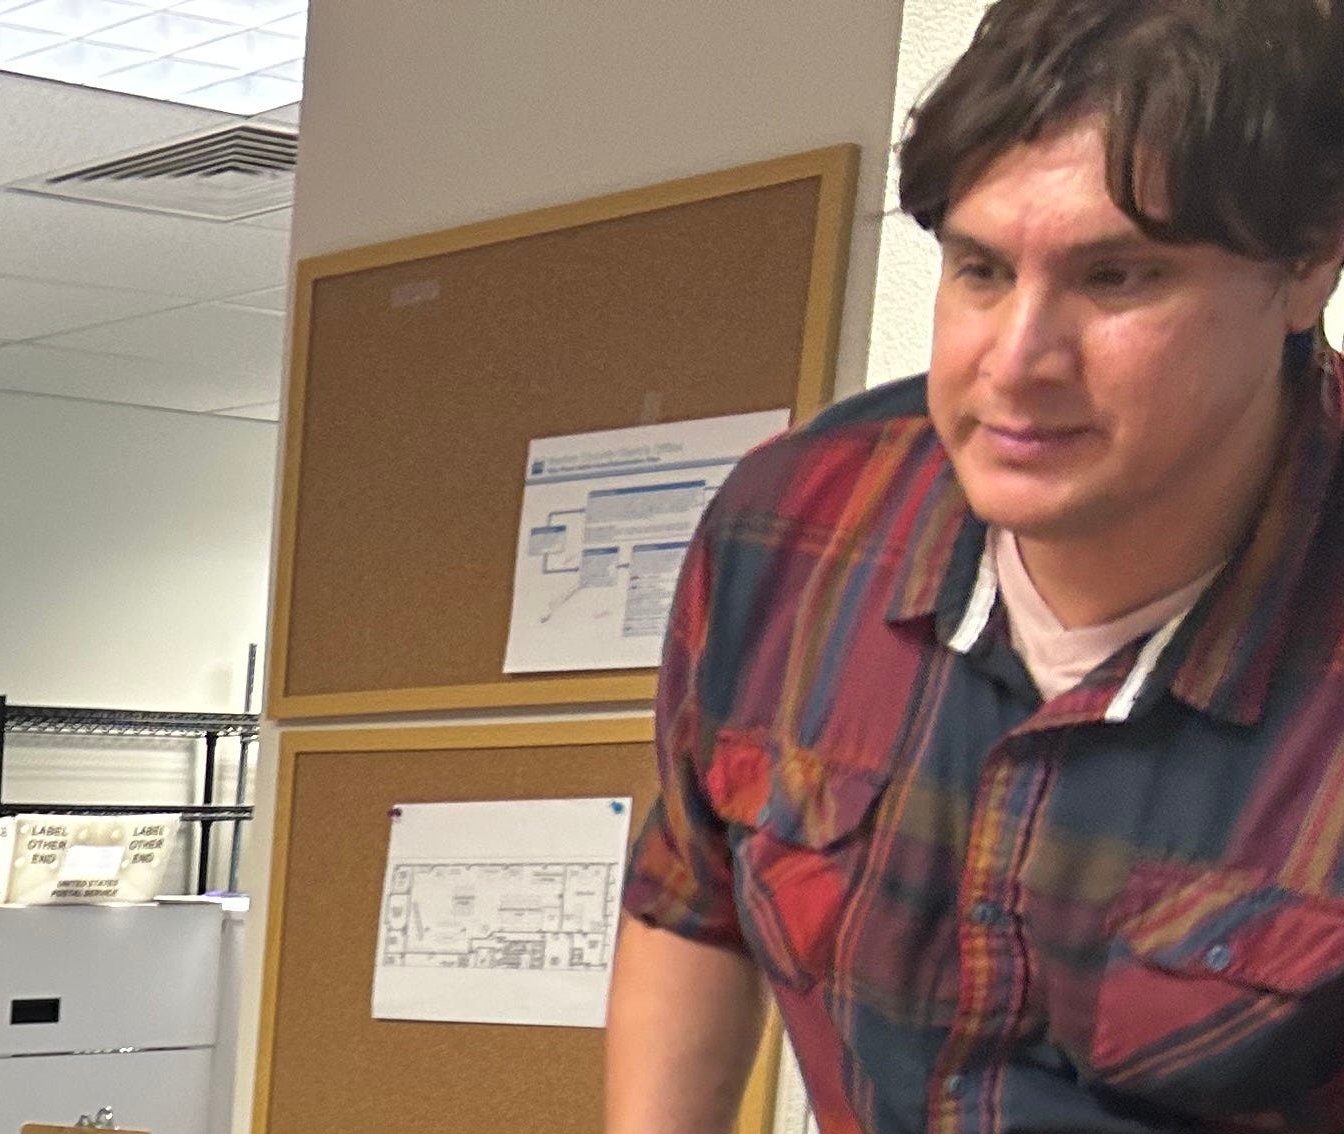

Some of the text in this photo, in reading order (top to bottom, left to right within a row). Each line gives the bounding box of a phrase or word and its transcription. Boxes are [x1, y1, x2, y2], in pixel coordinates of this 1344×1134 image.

[31, 825, 69, 837] LABEL
[132, 825, 165, 837] LABEL
[26, 839, 68, 851] OTHER
[128, 838, 166, 851] OTHER
[30, 853, 57, 865] END
[131, 852, 155, 864] END
